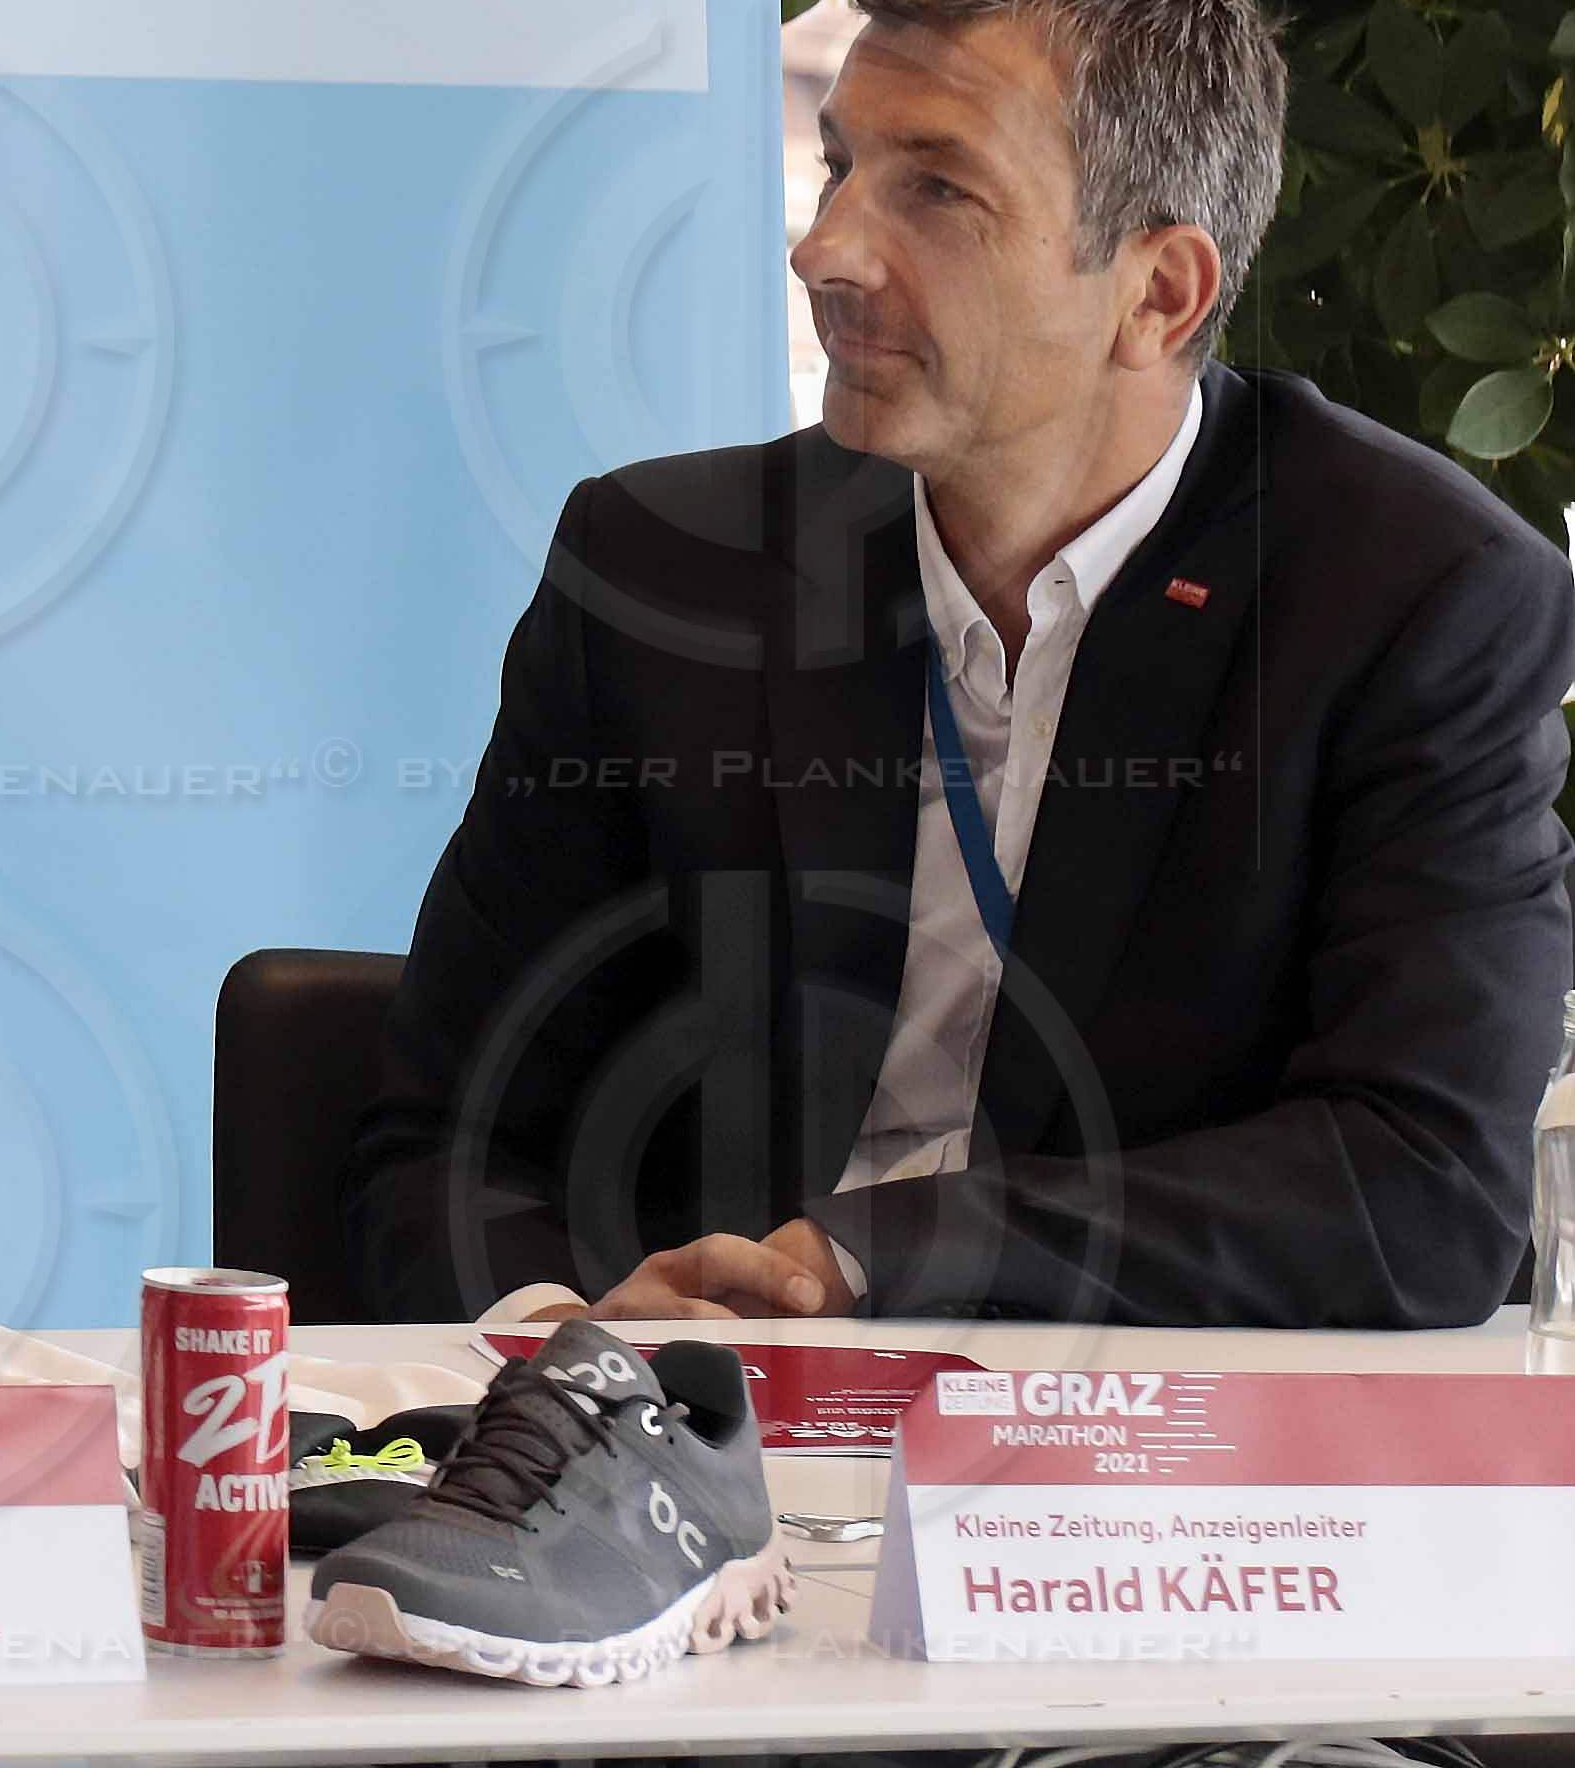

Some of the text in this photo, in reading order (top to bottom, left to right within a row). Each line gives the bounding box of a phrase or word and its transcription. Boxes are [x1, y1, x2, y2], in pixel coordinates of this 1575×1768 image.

[174, 1327, 273, 1355] SHAKE IT
[942, 1377, 1009, 1393] KLEINE
[1021, 1372, 1165, 1417] GRAZ
[991, 1423, 1128, 1448] MARATHON
[1094, 1451, 1150, 1474] 2021
[954, 1512, 1368, 1545] Kleine Zeitung, Anzeigenleiter
[961, 1553, 1345, 1615] Harald KÄFER
